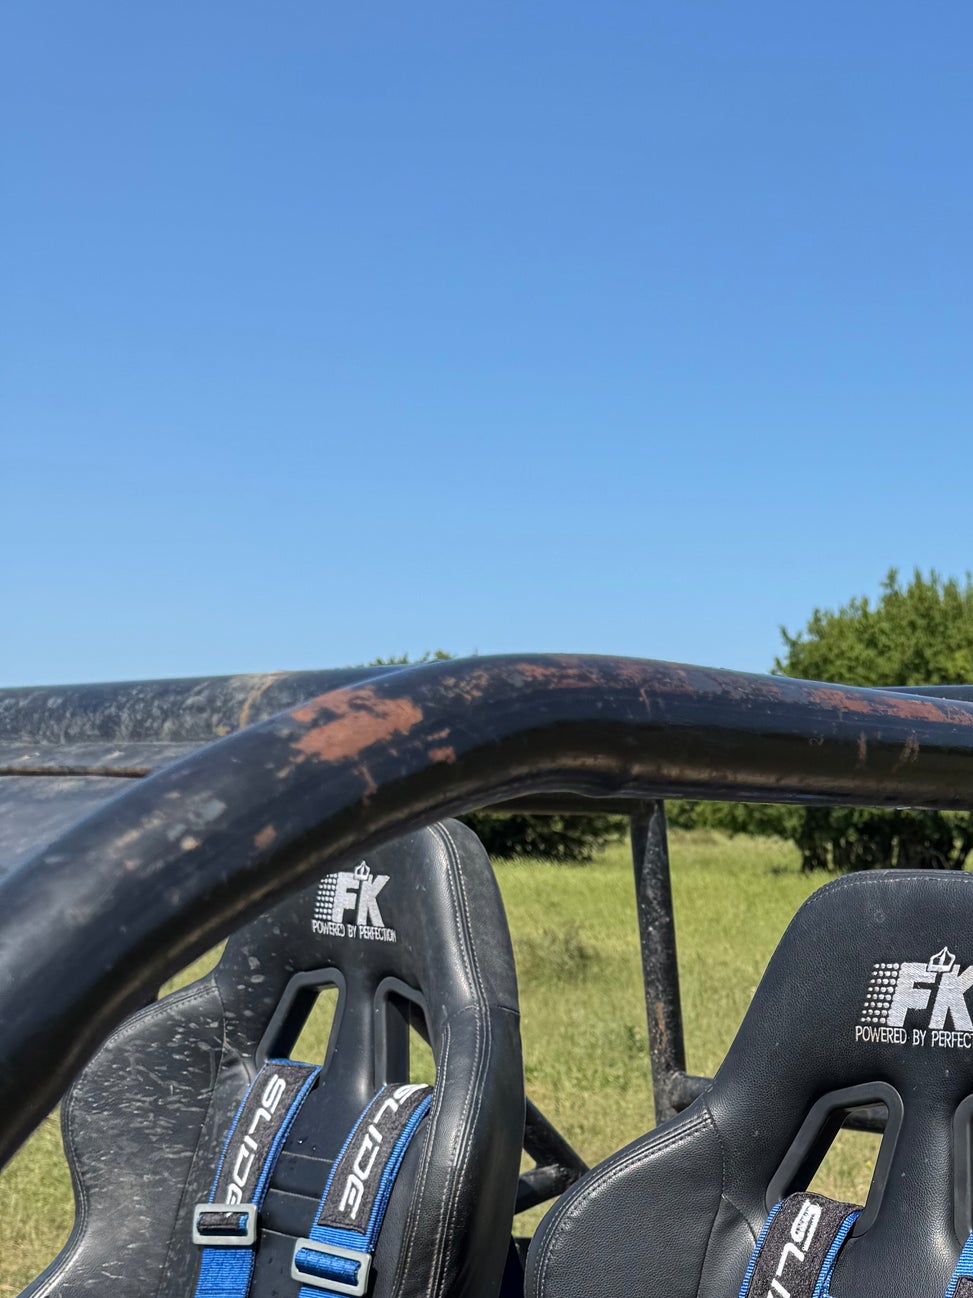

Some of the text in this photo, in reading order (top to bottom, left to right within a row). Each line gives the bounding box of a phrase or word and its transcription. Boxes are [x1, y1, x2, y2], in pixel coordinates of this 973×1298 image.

[330, 871, 390, 928] FK
[311, 919, 397, 942] POWERED BY PERFECTION
[855, 1025, 907, 1044] POWERED
[912, 1029, 927, 1046] BY
[339, 1084, 428, 1219] SLIDE
